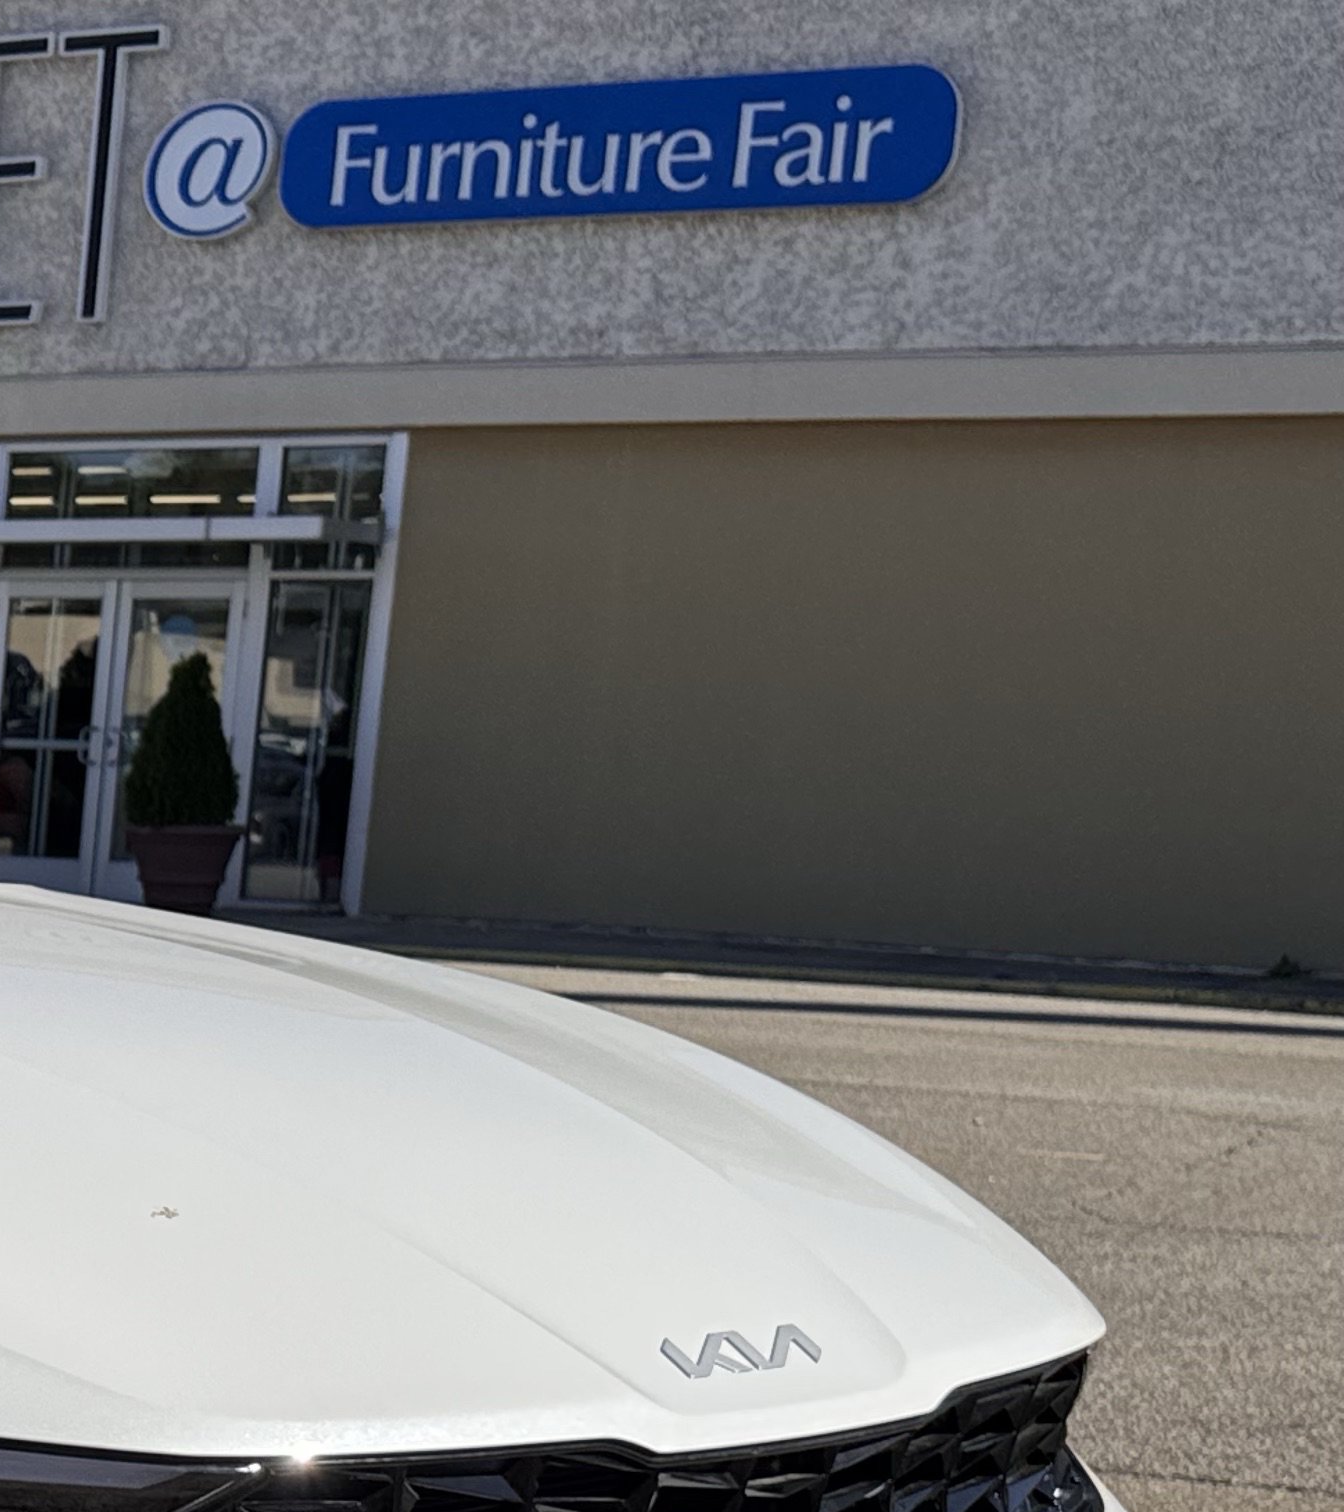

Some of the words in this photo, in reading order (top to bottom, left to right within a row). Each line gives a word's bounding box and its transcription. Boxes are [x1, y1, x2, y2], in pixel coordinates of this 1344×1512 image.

[146, 102, 271, 239] @
[328, 112, 714, 207] Furniture
[731, 94, 895, 189] Fair
